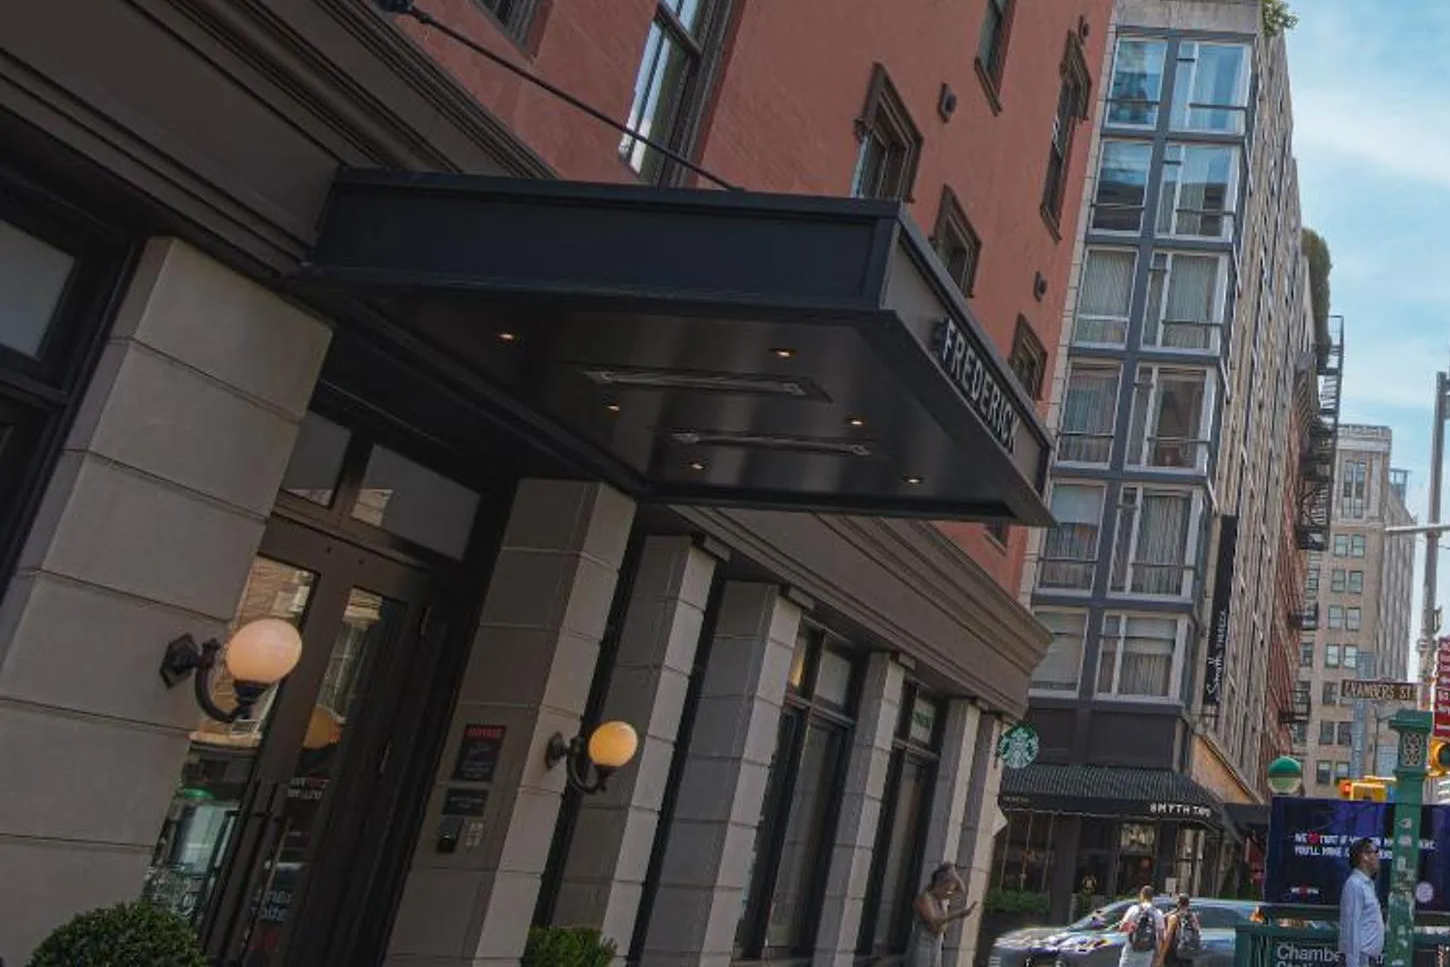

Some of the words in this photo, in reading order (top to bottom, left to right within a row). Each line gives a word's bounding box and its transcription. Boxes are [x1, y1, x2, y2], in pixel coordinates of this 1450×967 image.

[942, 317, 1020, 454] FREDERICK
[1150, 802, 1190, 815] SMYTH
[1277, 943, 1341, 962] Chambe
